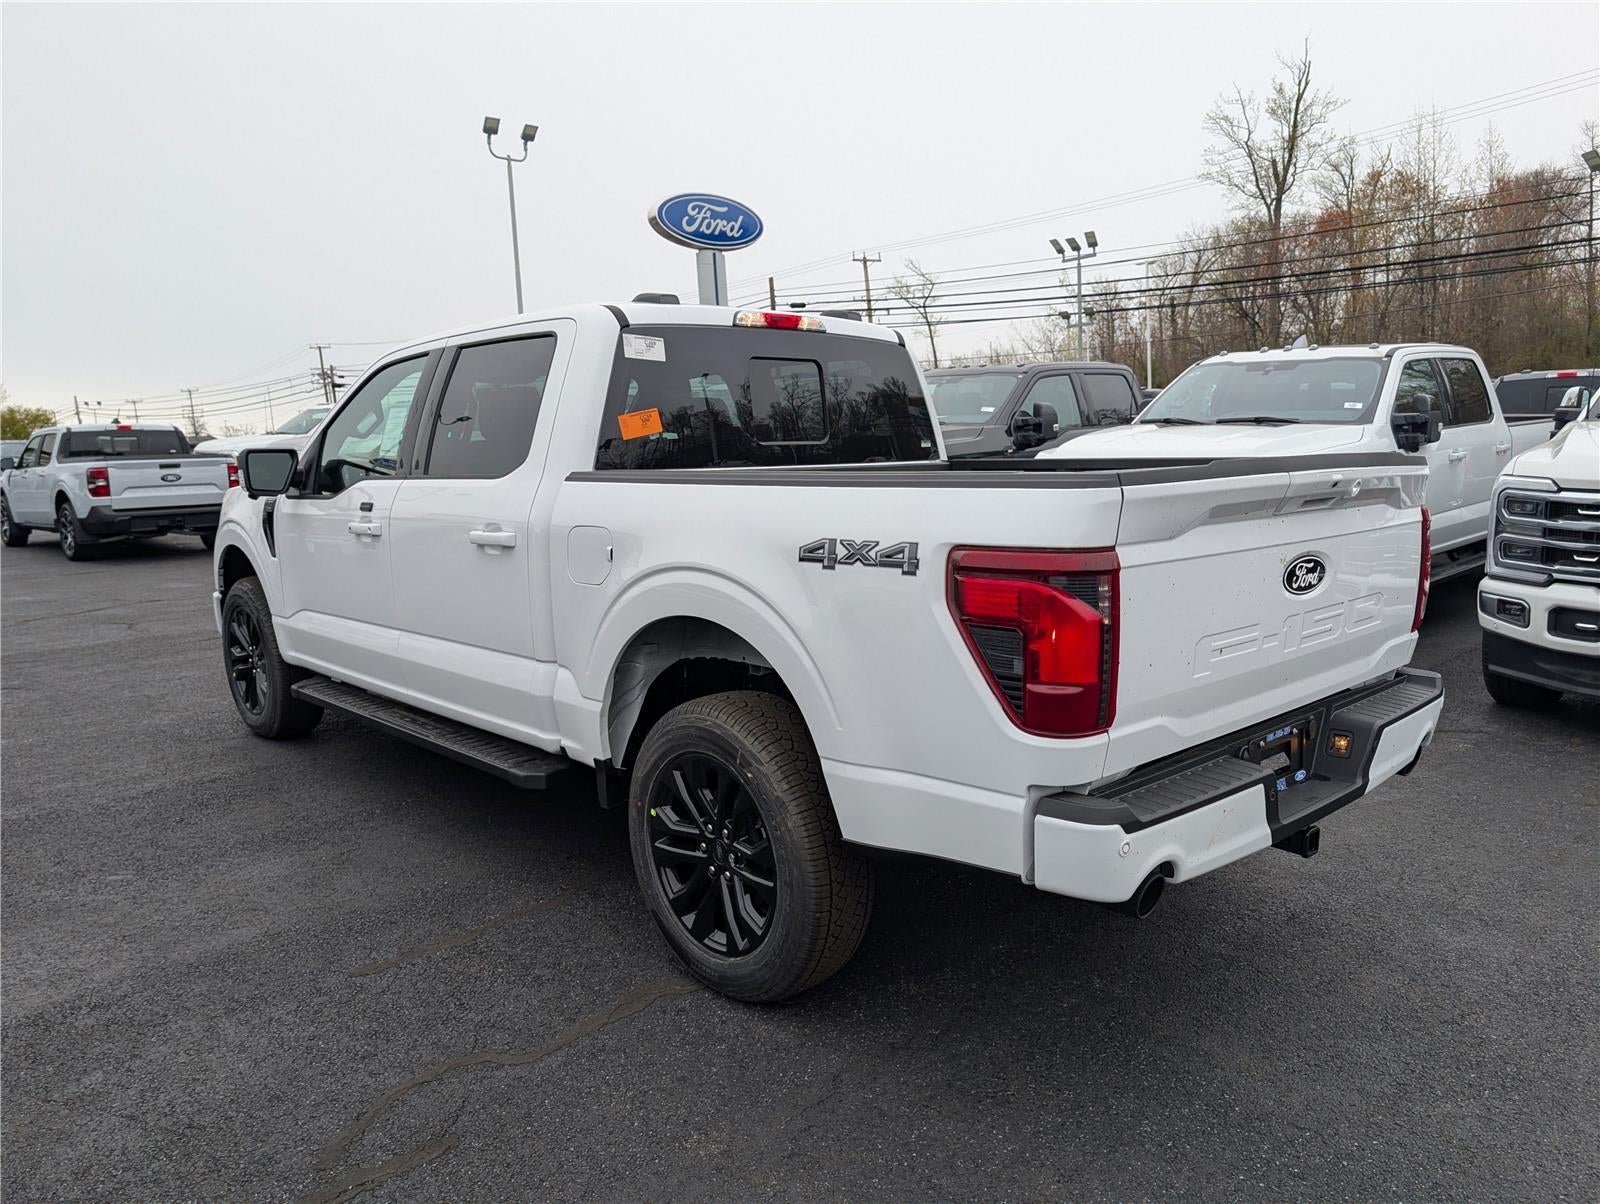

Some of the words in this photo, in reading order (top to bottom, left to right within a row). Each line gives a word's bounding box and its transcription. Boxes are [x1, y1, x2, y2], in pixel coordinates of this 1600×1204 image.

[682, 201, 743, 237] Ford
[1292, 561, 1320, 589] Ford
[1192, 591, 1386, 679] F-150
